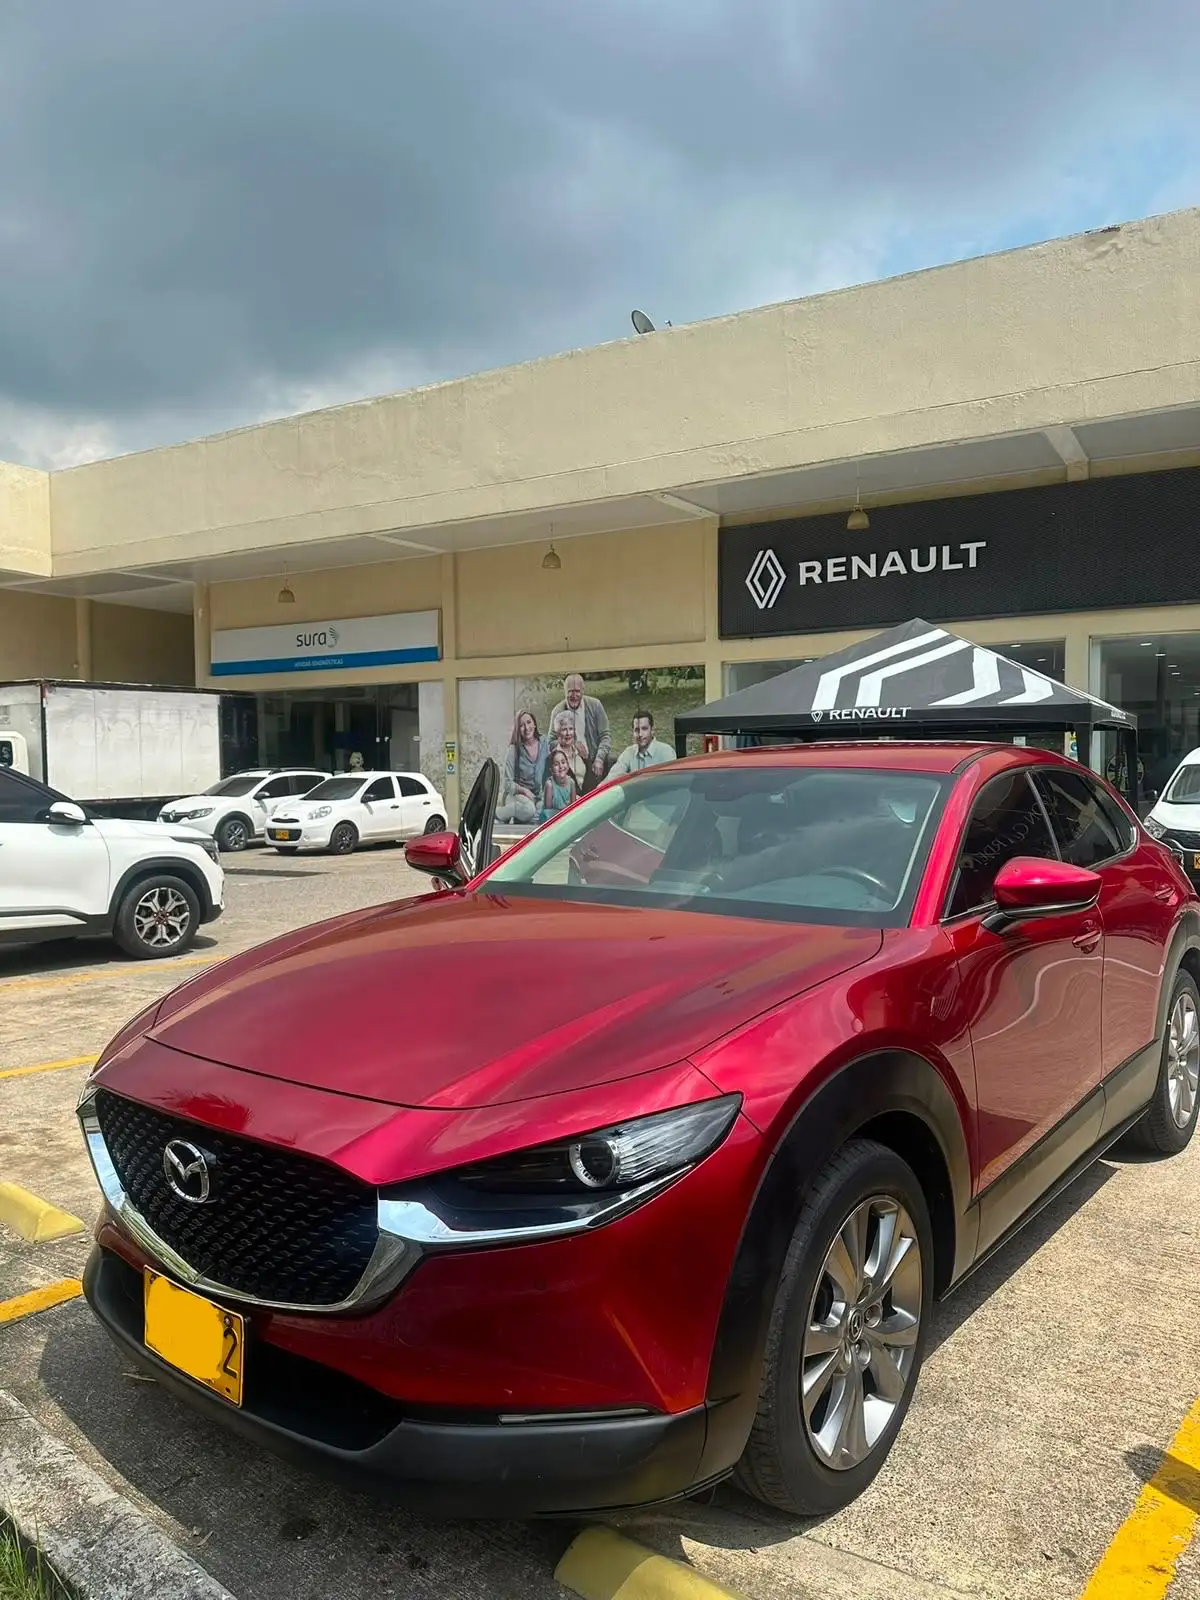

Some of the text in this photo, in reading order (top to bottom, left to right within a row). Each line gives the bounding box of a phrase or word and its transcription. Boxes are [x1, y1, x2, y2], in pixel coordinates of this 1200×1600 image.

[798, 541, 987, 586] RENAULT
[296, 632, 327, 648] sura
[829, 707, 912, 720] RENAULT
